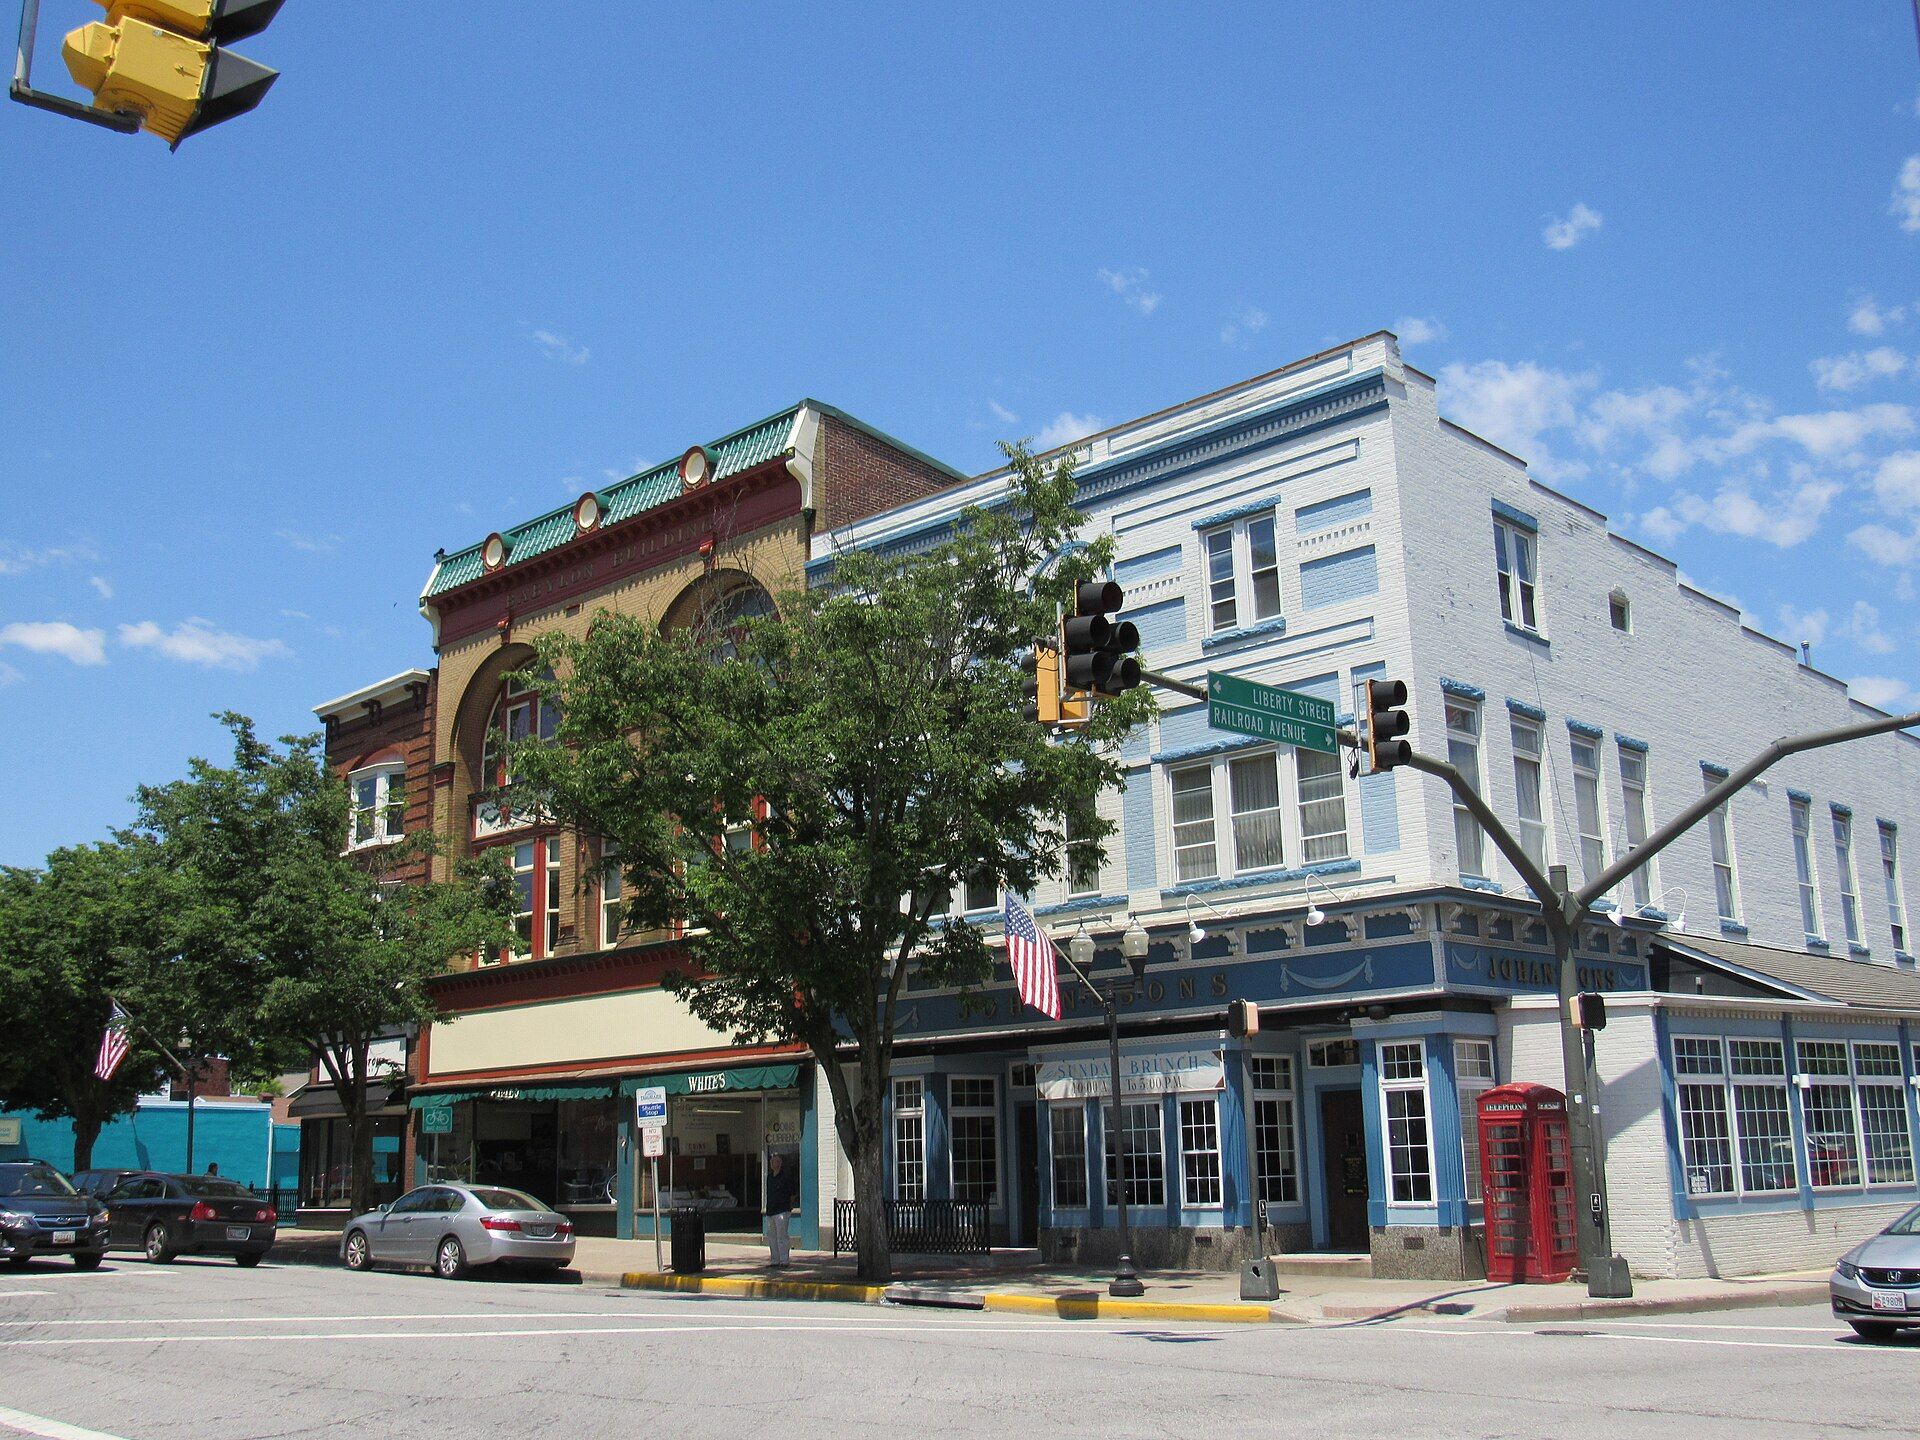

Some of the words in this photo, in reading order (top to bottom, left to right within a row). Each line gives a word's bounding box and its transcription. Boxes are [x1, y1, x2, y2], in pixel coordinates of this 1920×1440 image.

[506, 563, 594, 607] BABYLON
[612, 520, 713, 569] BUILDING
[1252, 688, 1293, 713] LIBERTY
[1298, 700, 1331, 722] STREET
[1213, 707, 1264, 733] RAILROAD
[1269, 720, 1307, 742] AVENUE
[1489, 955, 1617, 990] JOHANONS
[1056, 1062, 1111, 1078] SUNDA
[1130, 1055, 1198, 1074] BRUNCH
[641, 1104, 662, 1112] Shuttle
[1485, 1102, 1527, 1112] TELEPHONE
